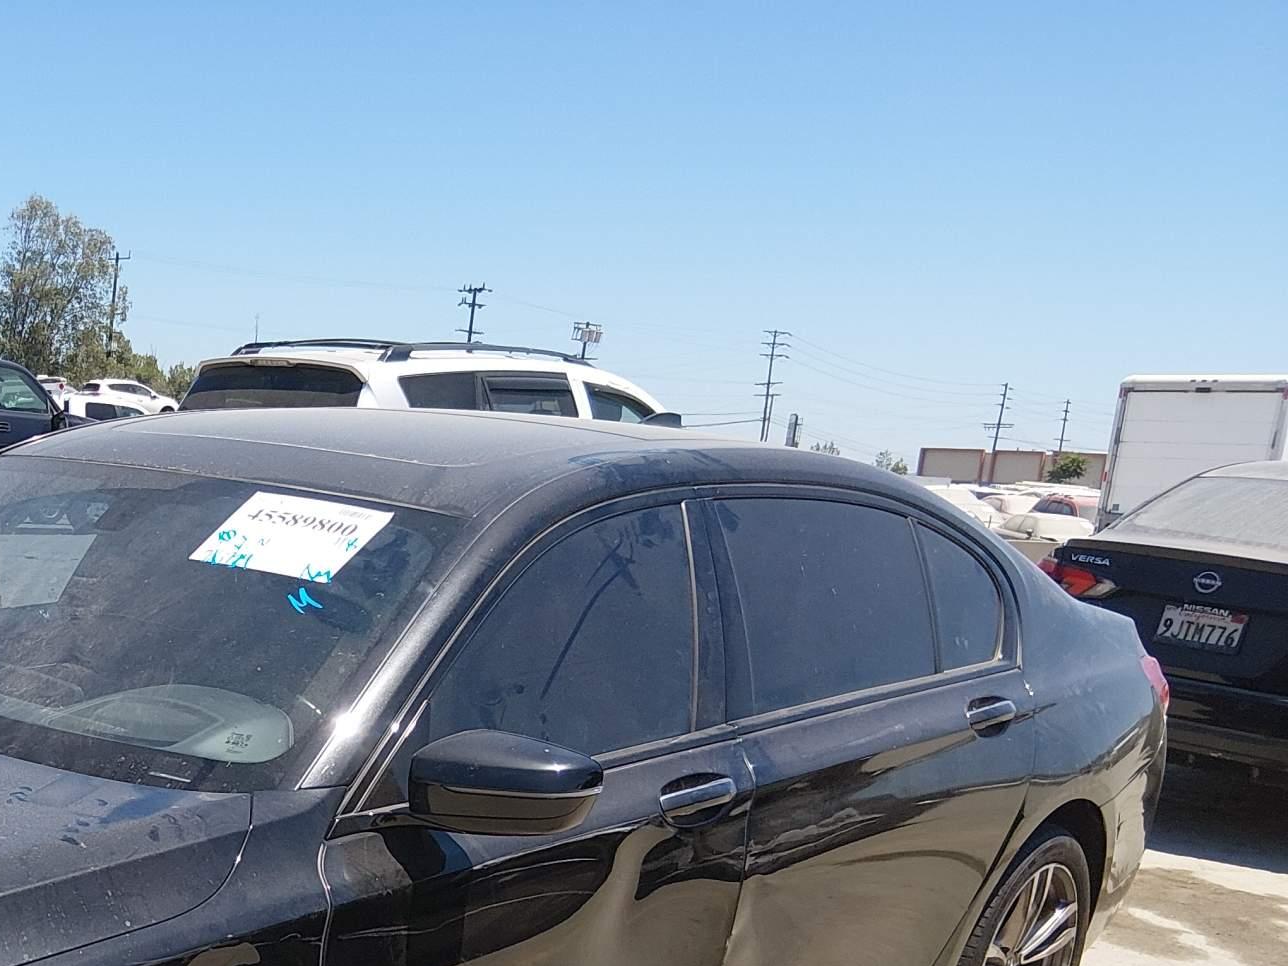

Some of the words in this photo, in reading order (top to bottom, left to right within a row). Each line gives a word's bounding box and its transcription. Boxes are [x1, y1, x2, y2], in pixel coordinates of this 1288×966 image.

[247, 508, 359, 537] 45589800
[1072, 553, 1109, 566] VERSA
[1183, 604, 1230, 617] NISSAN
[1158, 618, 1239, 646] 9JTM776
